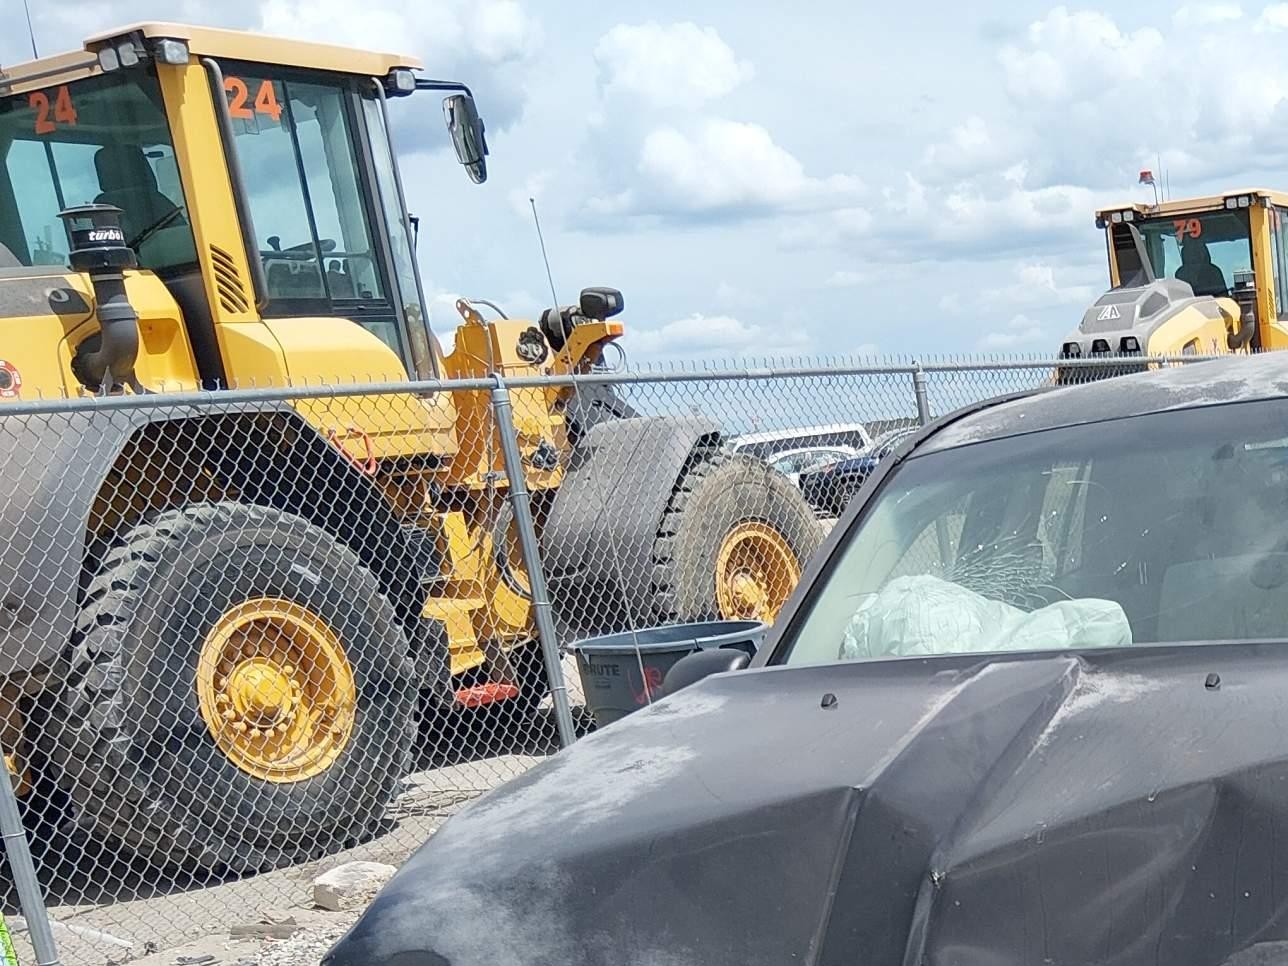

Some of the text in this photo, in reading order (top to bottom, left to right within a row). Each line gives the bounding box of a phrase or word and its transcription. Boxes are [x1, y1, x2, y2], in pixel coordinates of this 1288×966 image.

[28, 85, 78, 135] 24
[224, 76, 282, 121] 24
[1173, 218, 1202, 241] 79
